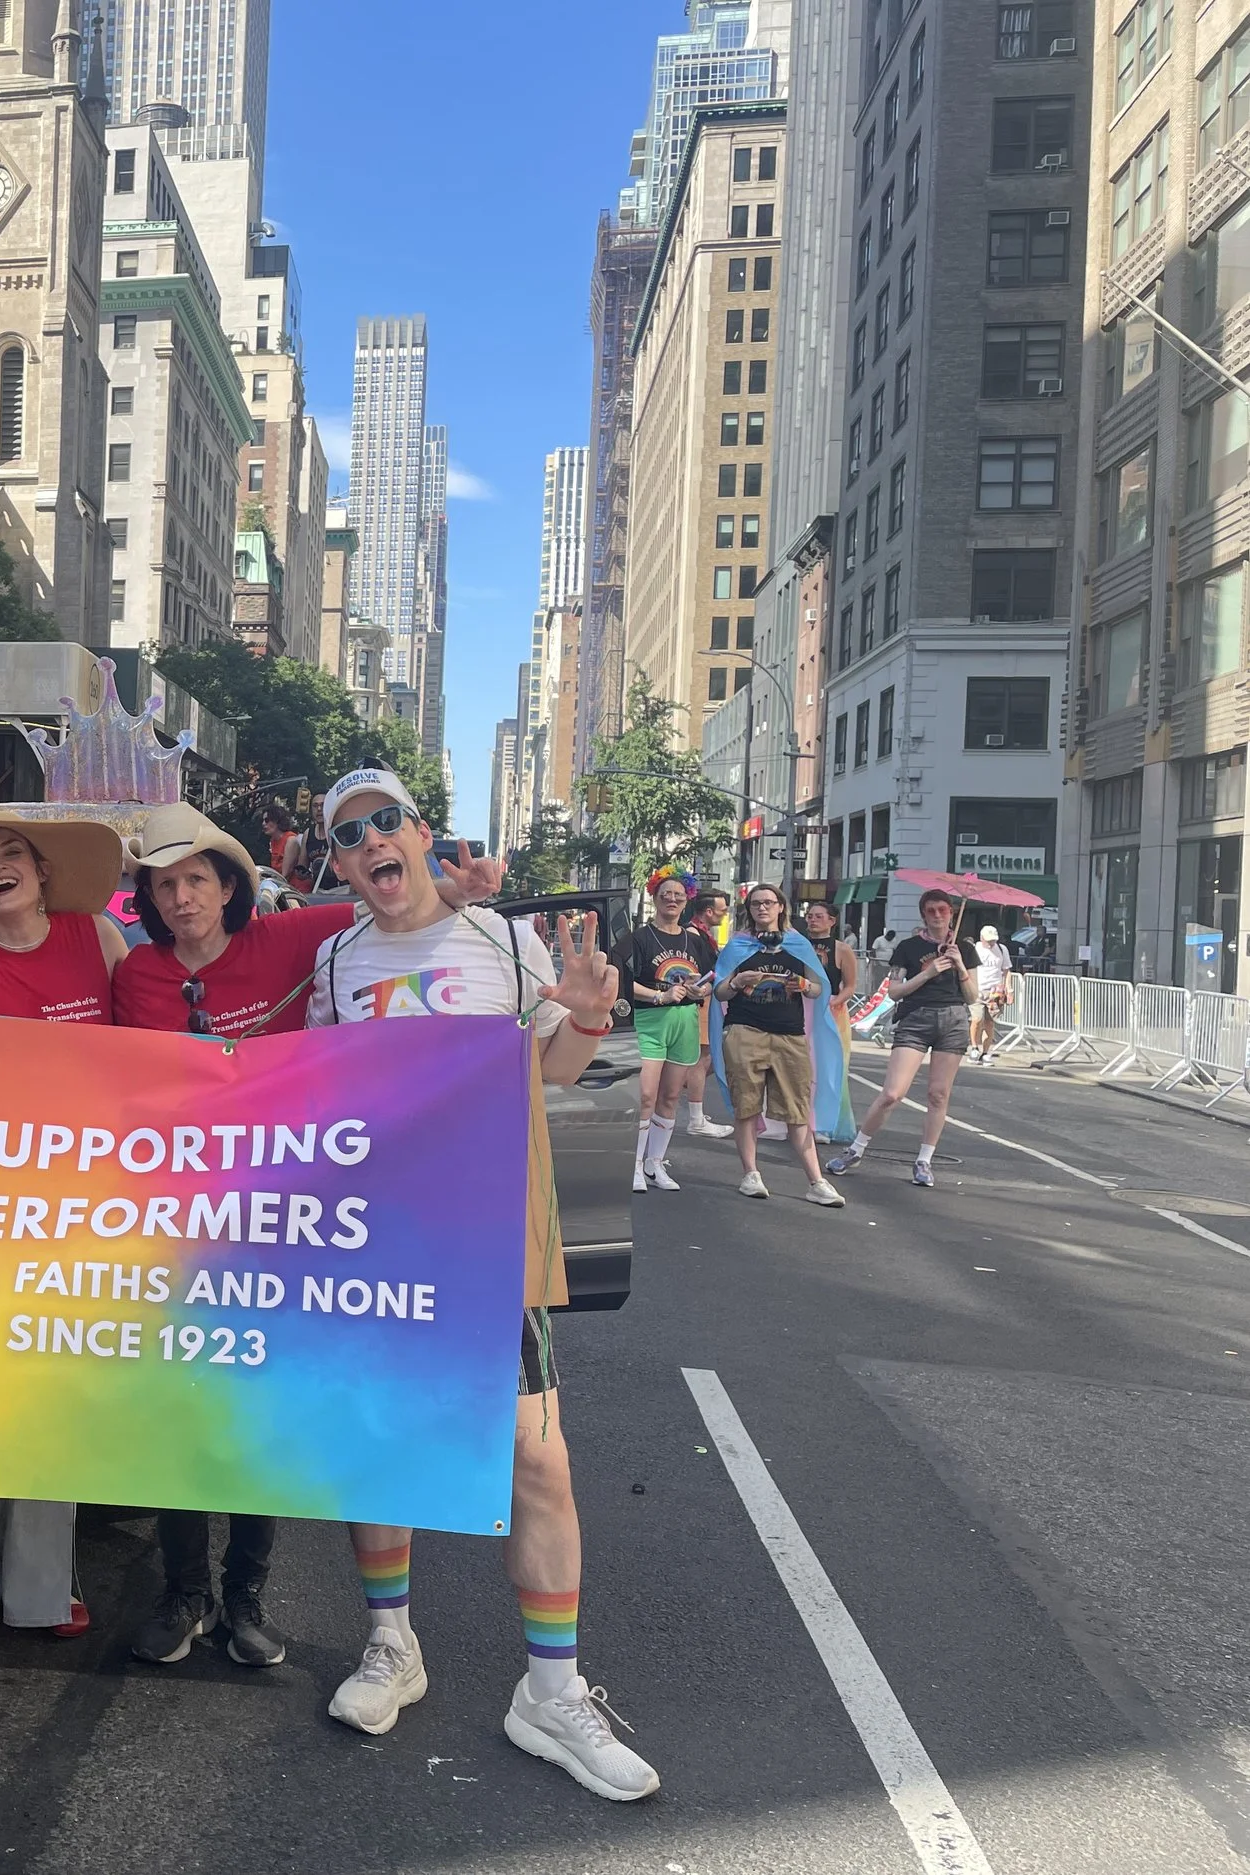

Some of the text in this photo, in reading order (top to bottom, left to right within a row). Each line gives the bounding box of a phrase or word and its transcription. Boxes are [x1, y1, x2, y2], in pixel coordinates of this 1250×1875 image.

[336, 772, 380, 792] RESOLVE
[977, 854, 1042, 871] Citizens
[652, 949, 674, 967] PRIDE
[676, 950, 688, 960] OR
[1203, 945, 1214, 961] P
[41, 1005, 55, 1013] The
[56, 1000, 82, 1010] Church
[47, 1009, 102, 1021] Transfiguration
[221, 1007, 248, 1020] Church
[257, 1001, 269, 1009] the
[13, 1261, 171, 1303] FAITHS
[184, 1269, 286, 1309] AND
[302, 1275, 436, 1321] NONE
[6, 1315, 267, 1366] SINCE 1923
